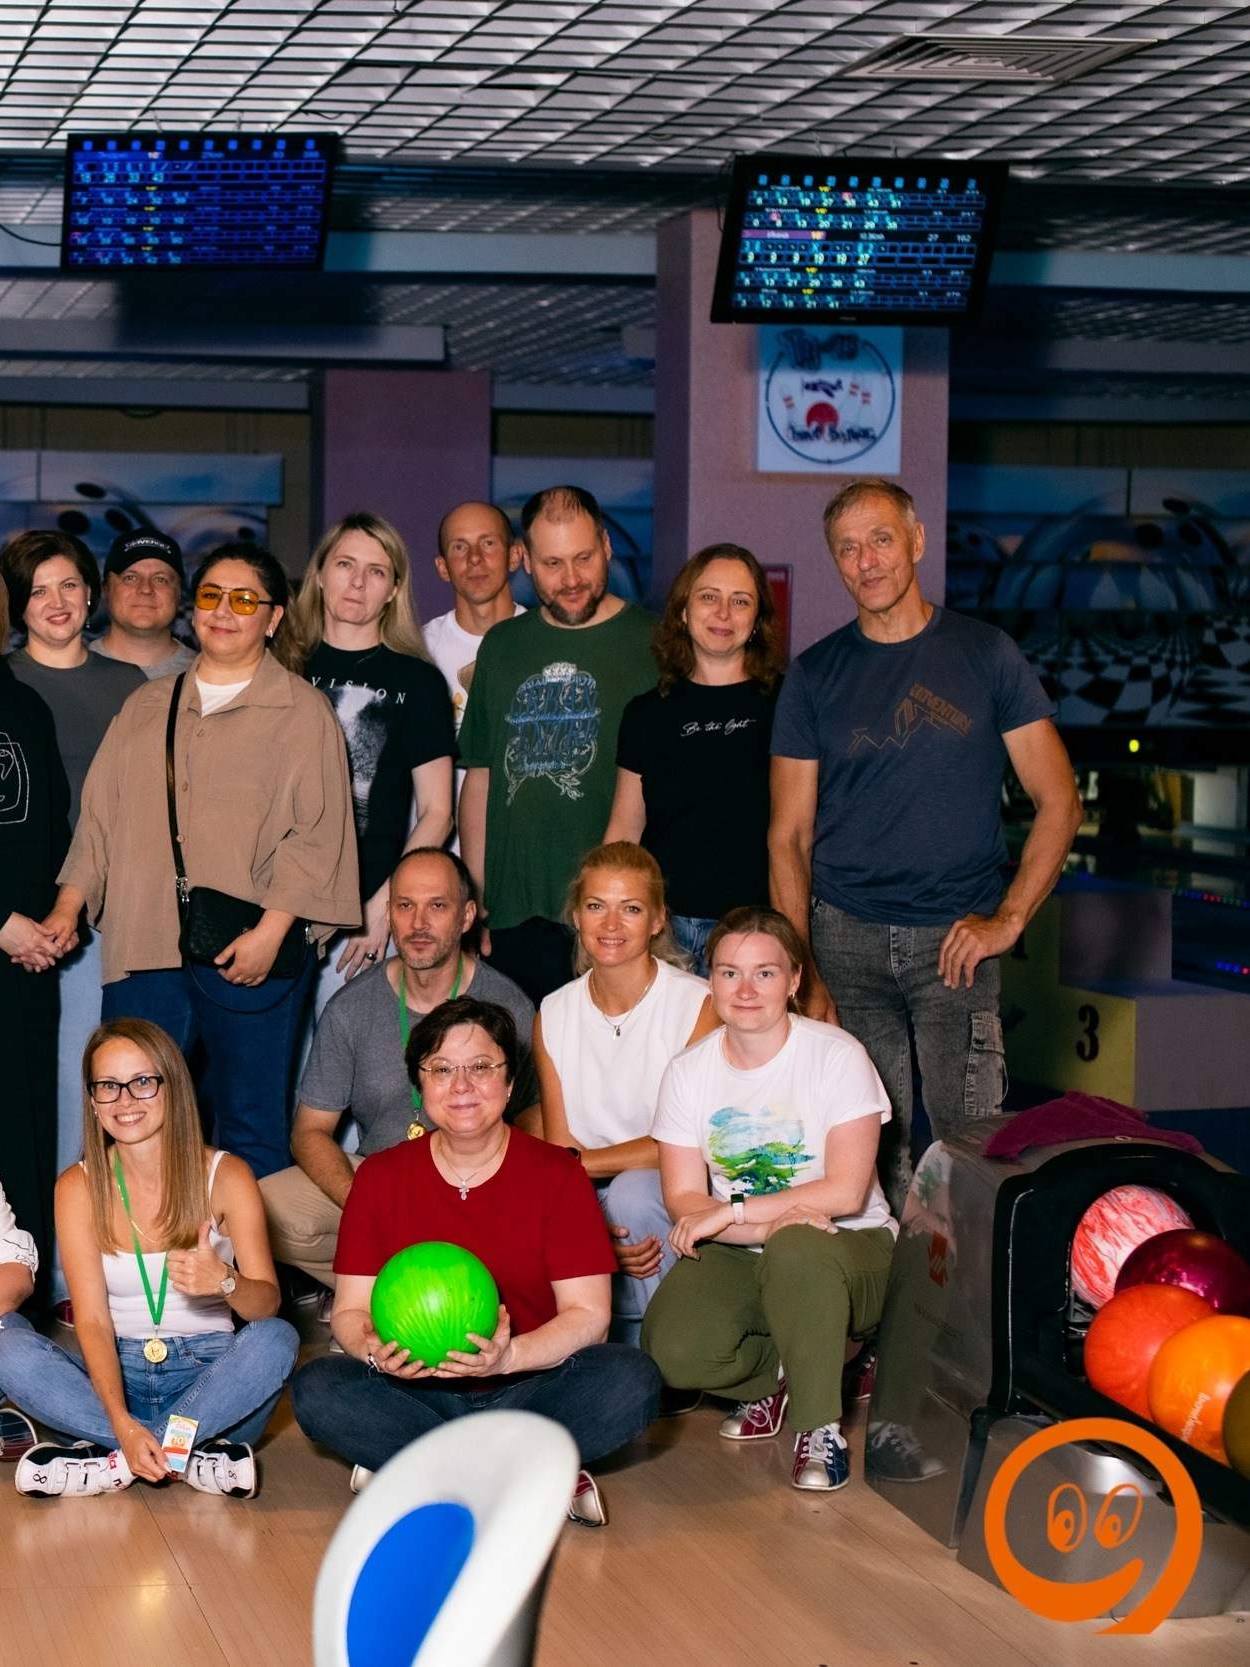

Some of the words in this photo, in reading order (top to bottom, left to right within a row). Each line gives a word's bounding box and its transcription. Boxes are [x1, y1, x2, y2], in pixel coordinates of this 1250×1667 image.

[681, 721, 701, 736] Be
[705, 720, 722, 732] the
[1076, 1004, 1100, 1063] 3
